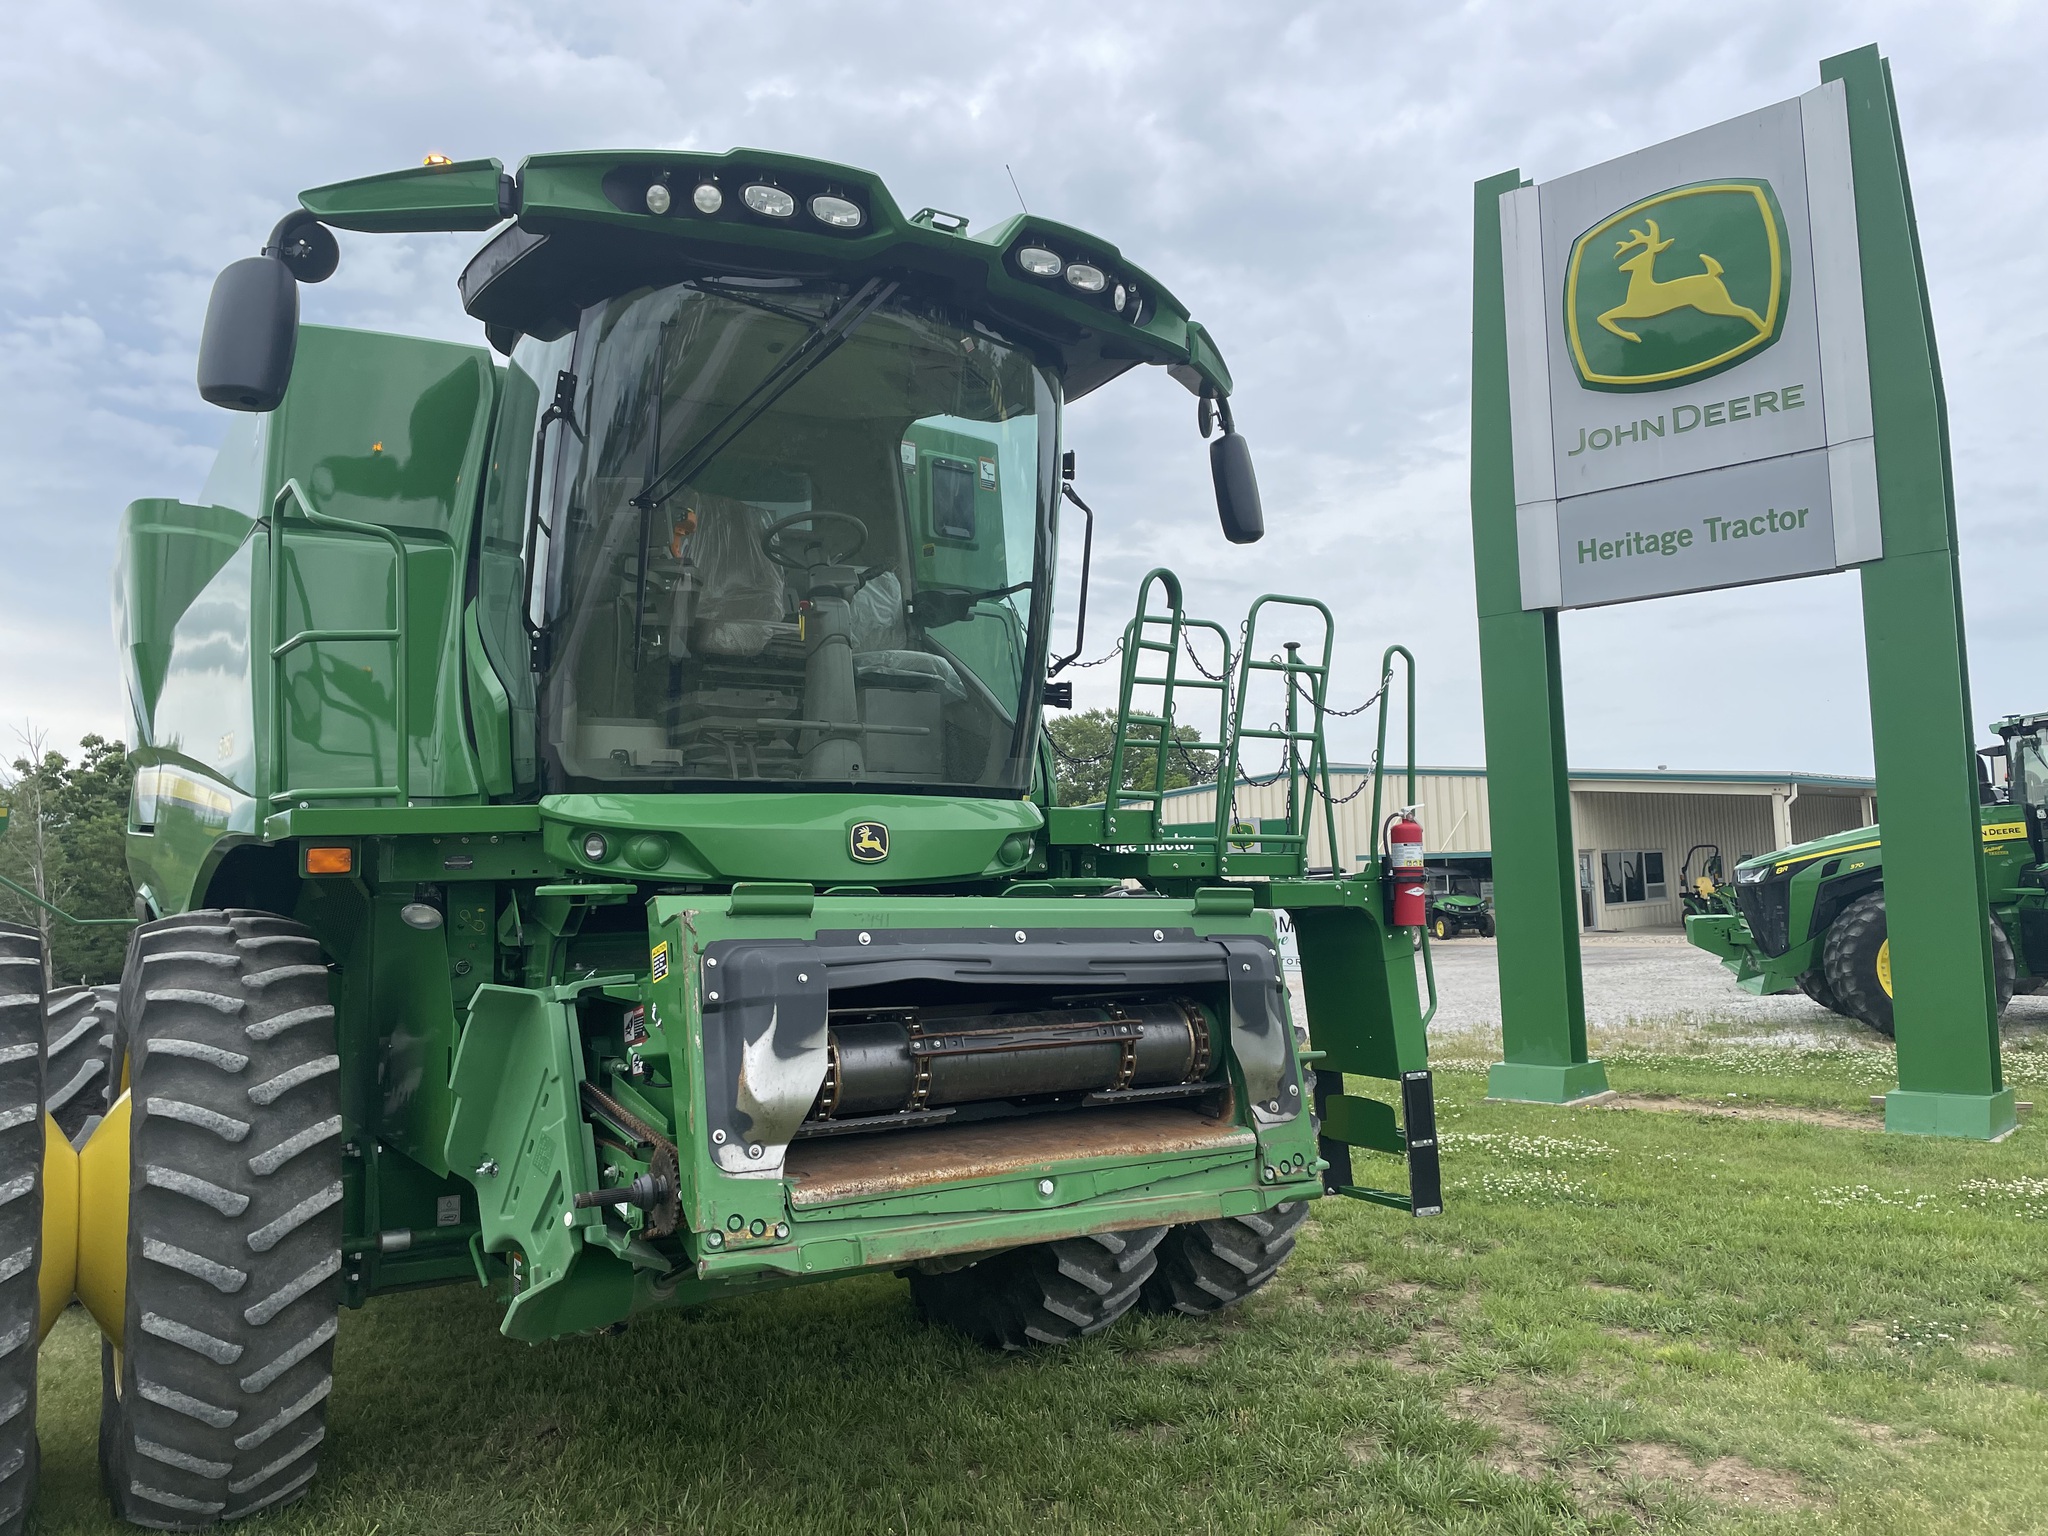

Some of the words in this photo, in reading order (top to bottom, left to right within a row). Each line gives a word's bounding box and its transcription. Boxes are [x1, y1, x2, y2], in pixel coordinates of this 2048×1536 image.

[1567, 415, 1666, 457] JOHN
[1672, 384, 1805, 434] DEERE
[1577, 528, 1693, 564] Heritage
[1702, 508, 1809, 543] Tractor
[1988, 827, 2021, 836] DEERE
[1775, 865, 1789, 875] 8R
